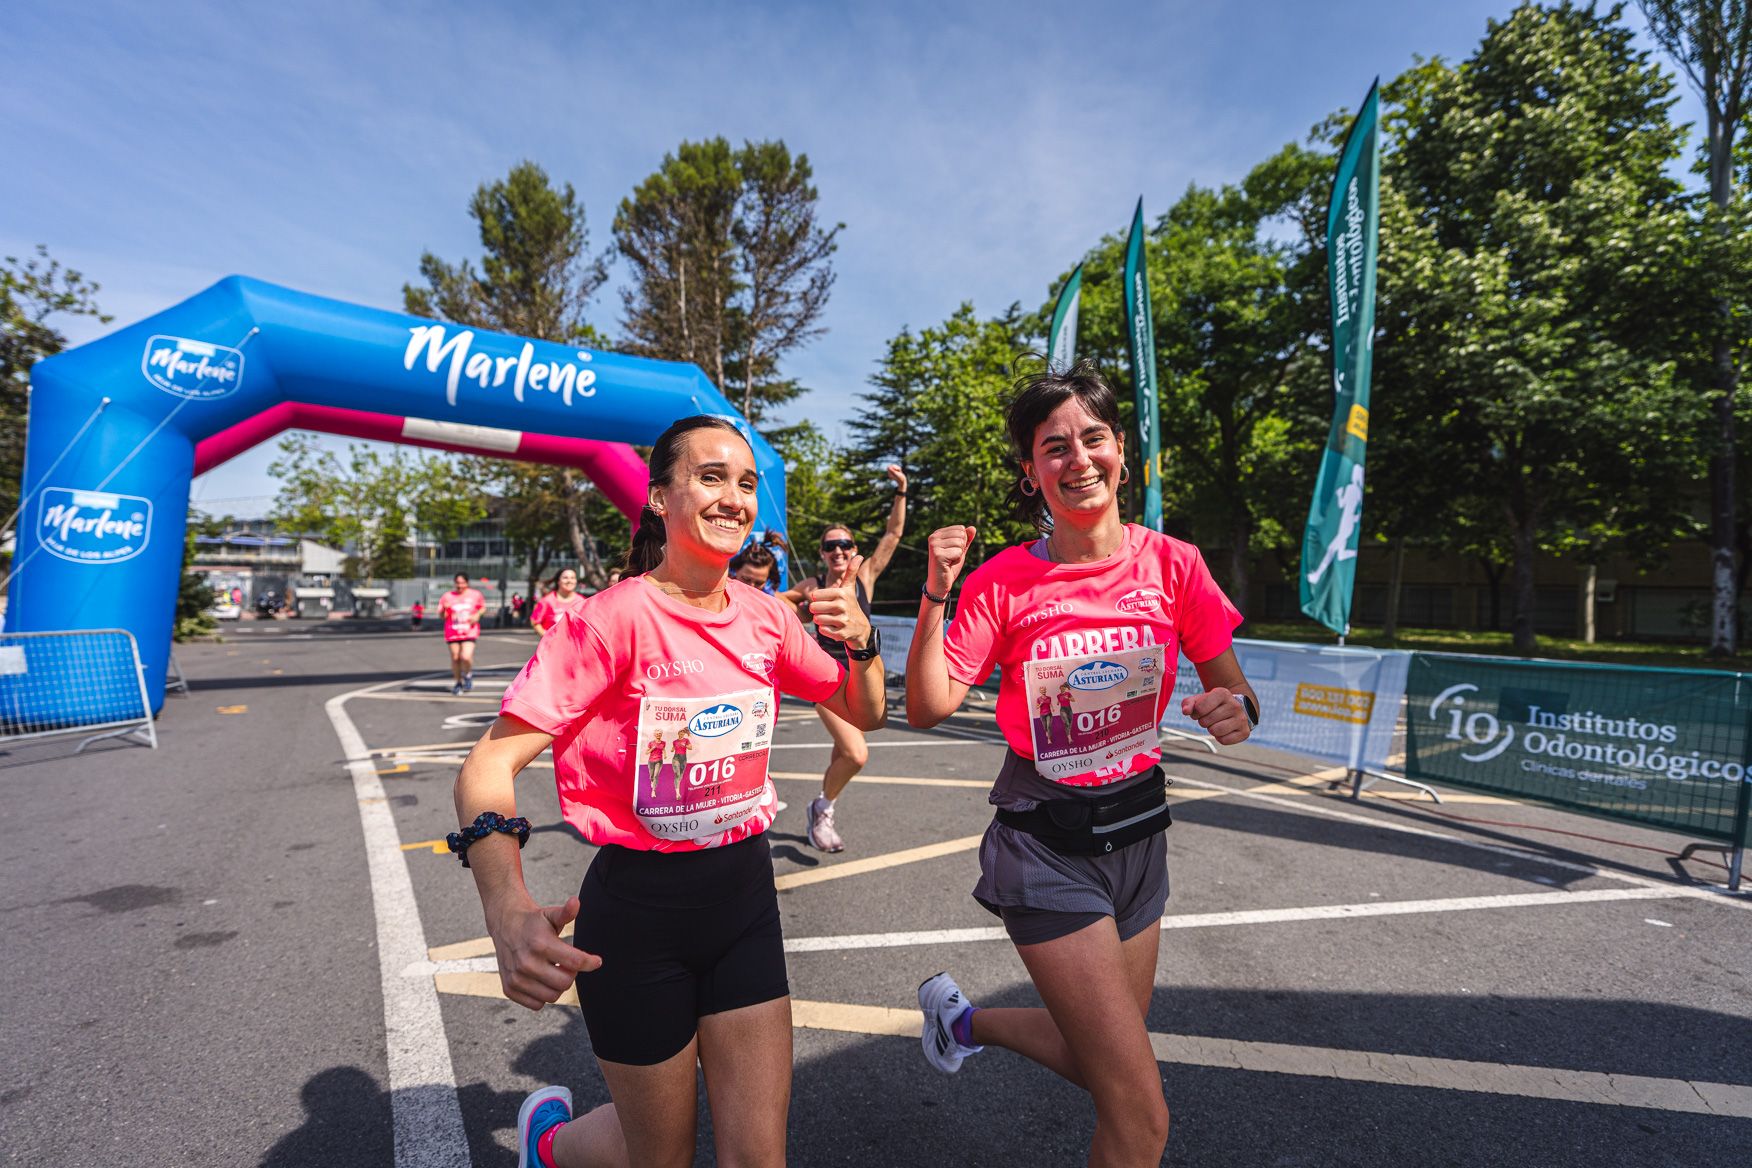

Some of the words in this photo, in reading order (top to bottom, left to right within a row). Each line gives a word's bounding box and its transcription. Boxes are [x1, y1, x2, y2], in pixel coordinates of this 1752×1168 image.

[150, 348, 236, 383] Marlene
[403, 325, 596, 406] Marlene
[43, 504, 144, 542] Marlene
[1020, 602, 1074, 628] OYSHO
[646, 659, 704, 680] OYSHO
[1037, 670, 1065, 680] SUMA
[1073, 672, 1125, 686] ASTURIANA
[655, 711, 687, 722] SUMA
[663, 705, 687, 713] DORSAL
[693, 716, 739, 731] ASTURIANA
[1077, 704, 1122, 732] 016
[1526, 705, 1678, 743] Institutos
[1040, 748, 1069, 760] CARRERA
[1069, 747, 1079, 755] DE
[1079, 745, 1088, 753] LA
[1114, 739, 1146, 757] Santander
[1523, 731, 1752, 782] Odontológicos
[689, 756, 735, 786] 016
[1051, 758, 1093, 773] OYSHO
[704, 785, 721, 797] 211
[639, 806, 674, 815] CARRERA
[675, 804, 685, 813] DE
[686, 803, 695, 812] LA
[695, 798, 717, 810] MUJER
[651, 820, 699, 833] OYSHO
